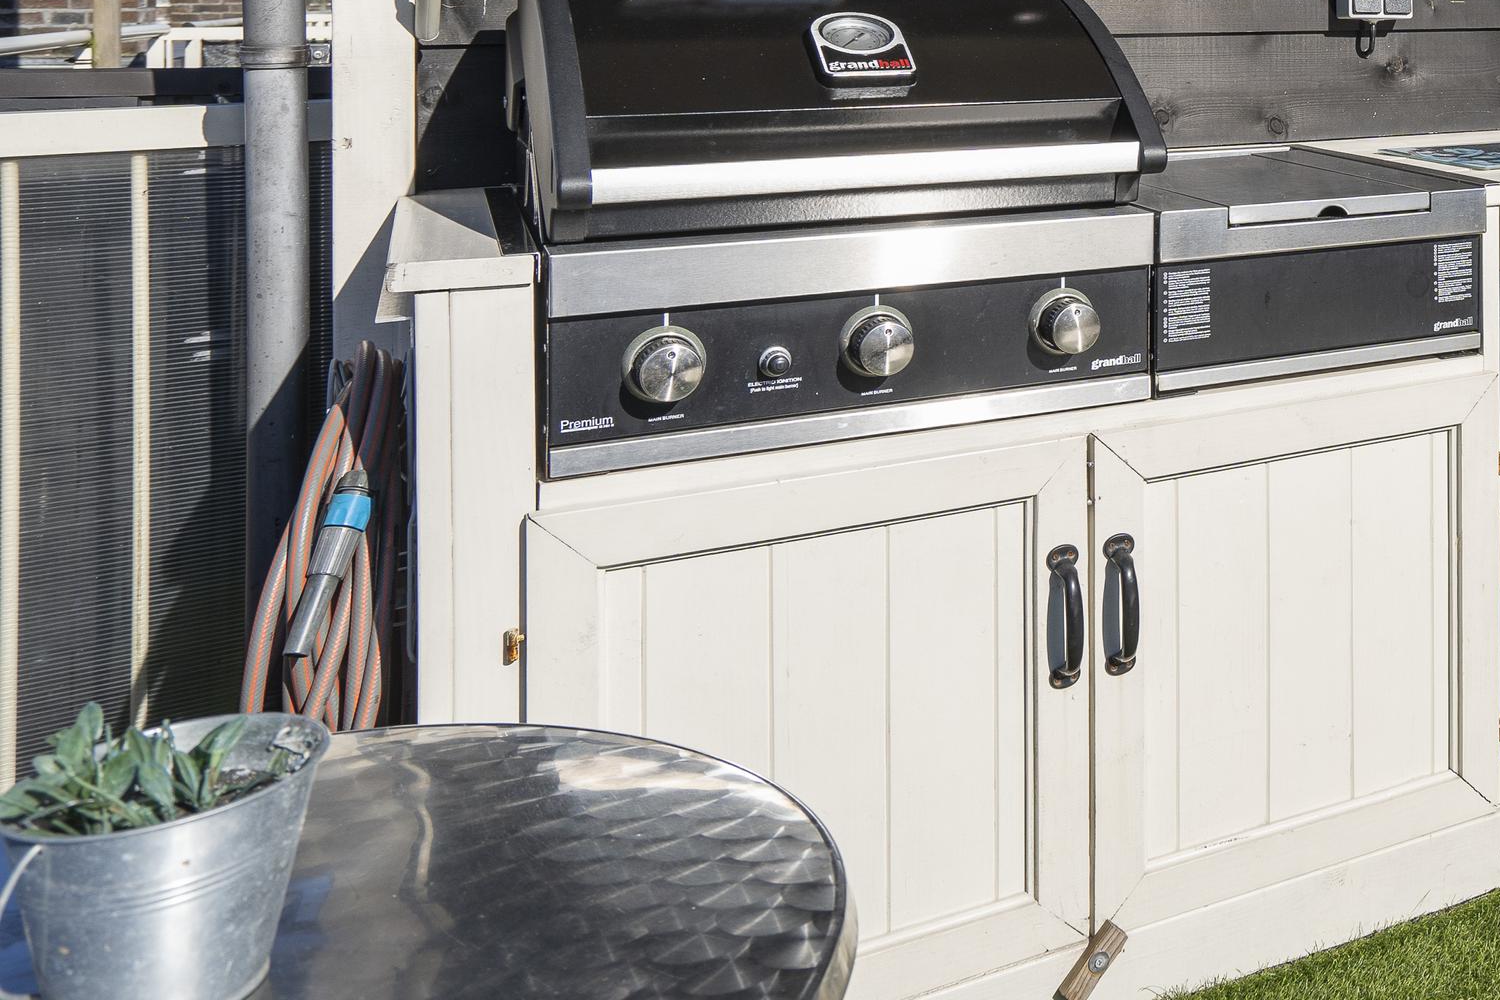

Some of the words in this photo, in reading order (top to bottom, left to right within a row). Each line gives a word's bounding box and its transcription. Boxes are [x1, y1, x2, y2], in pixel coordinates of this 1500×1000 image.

[829, 58, 911, 72] grandhall
[1433, 315, 1474, 332] grandhall
[1090, 352, 1142, 371] grandhall
[1060, 365, 1078, 373] BURNER
[747, 379, 776, 388] ELECTRIC
[776, 376, 803, 385] IGNITION
[560, 416, 614, 431] Premium
[662, 413, 685, 421] BURNER
